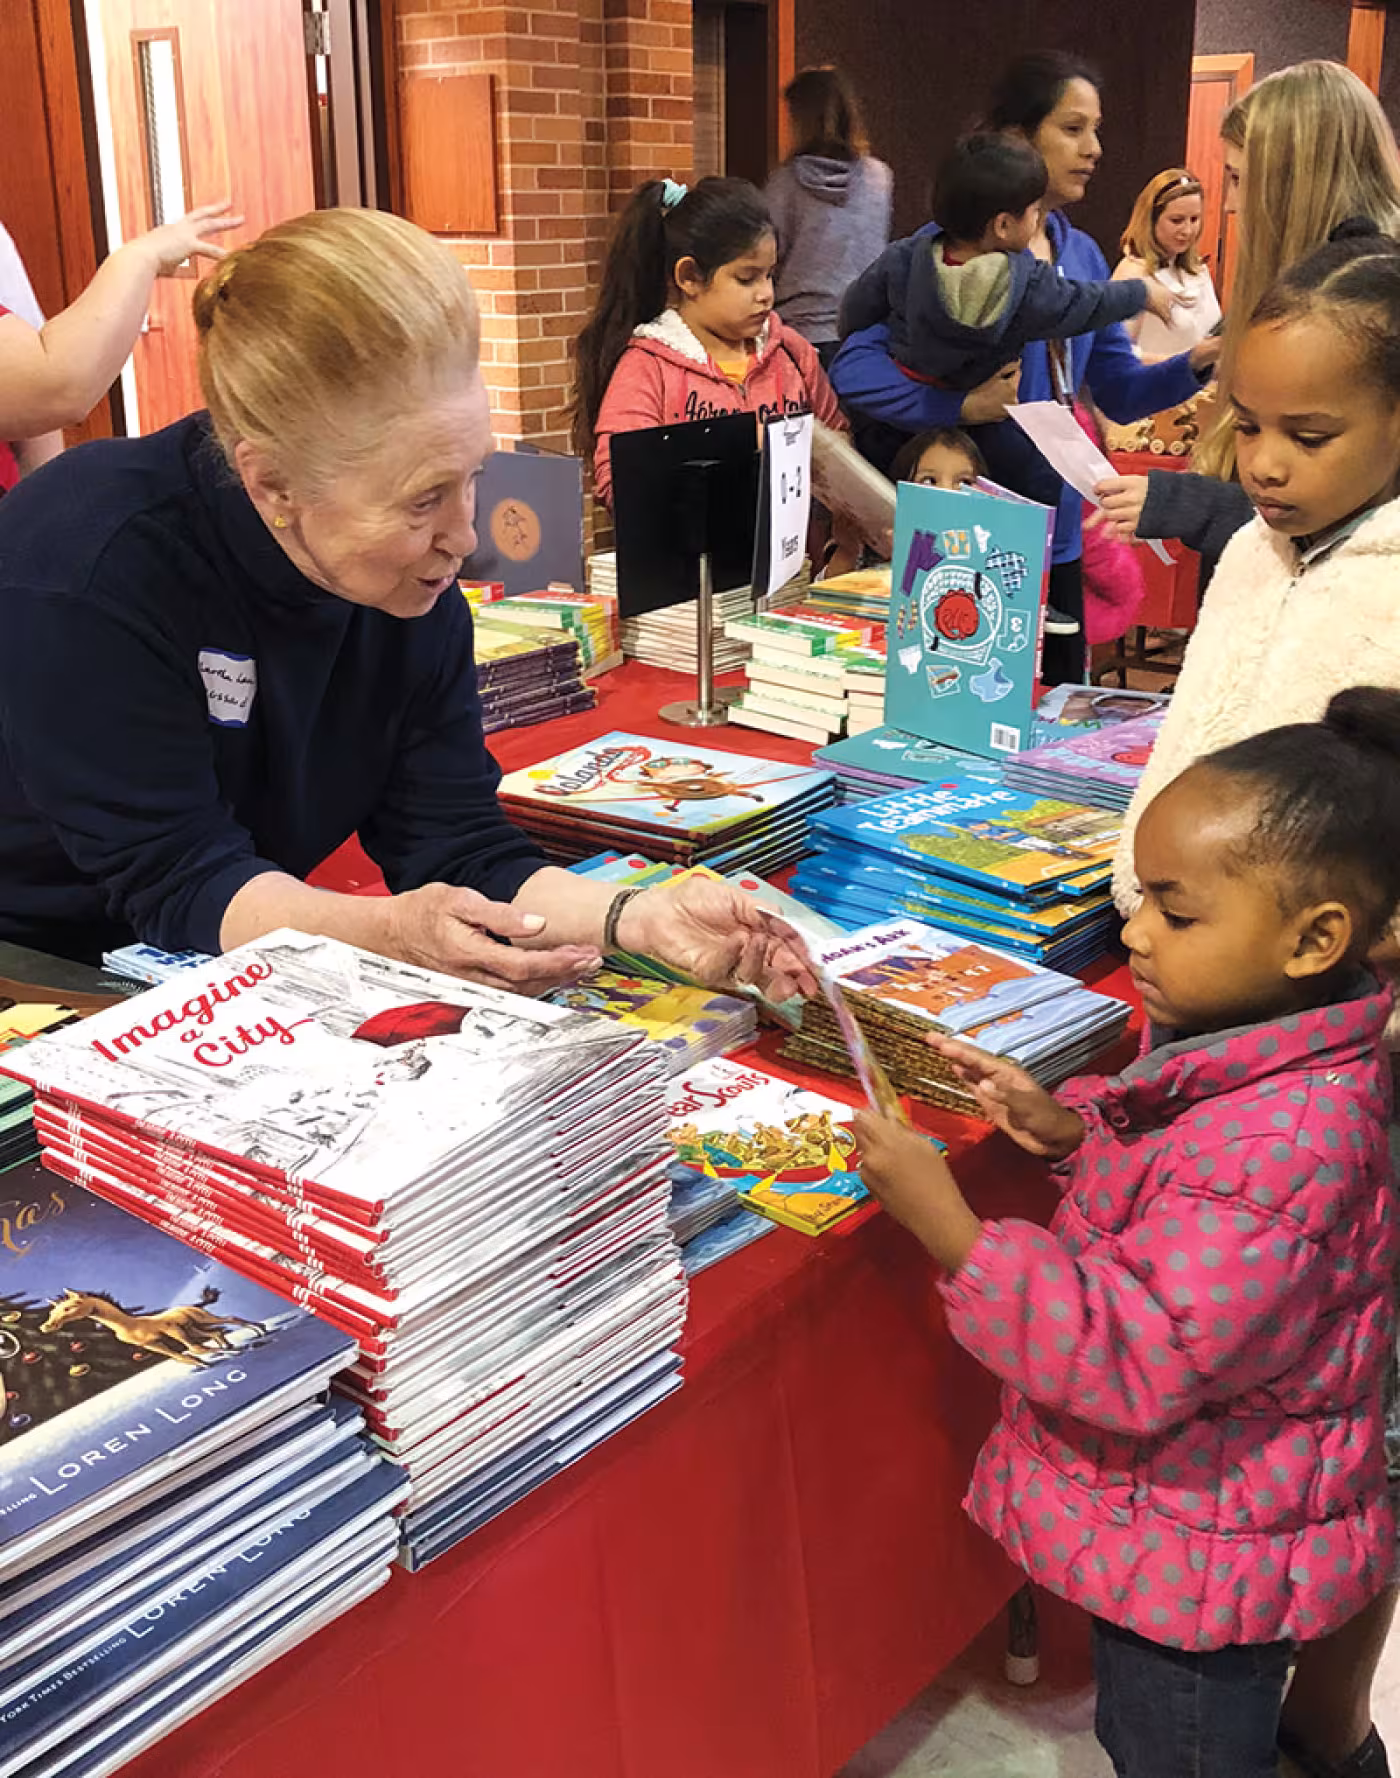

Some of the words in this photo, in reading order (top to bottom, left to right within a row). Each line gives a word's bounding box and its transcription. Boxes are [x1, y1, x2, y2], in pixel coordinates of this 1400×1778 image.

[855, 790, 1018, 834] Teammate
[857, 790, 960, 818] Little
[91, 962, 273, 1063] Imagine
[180, 1028, 204, 1044] a
[193, 1016, 316, 1067] City
[665, 1094, 705, 1118] ear
[29, 1422, 152, 1496] LOREN
[154, 1368, 248, 1425] LONG
